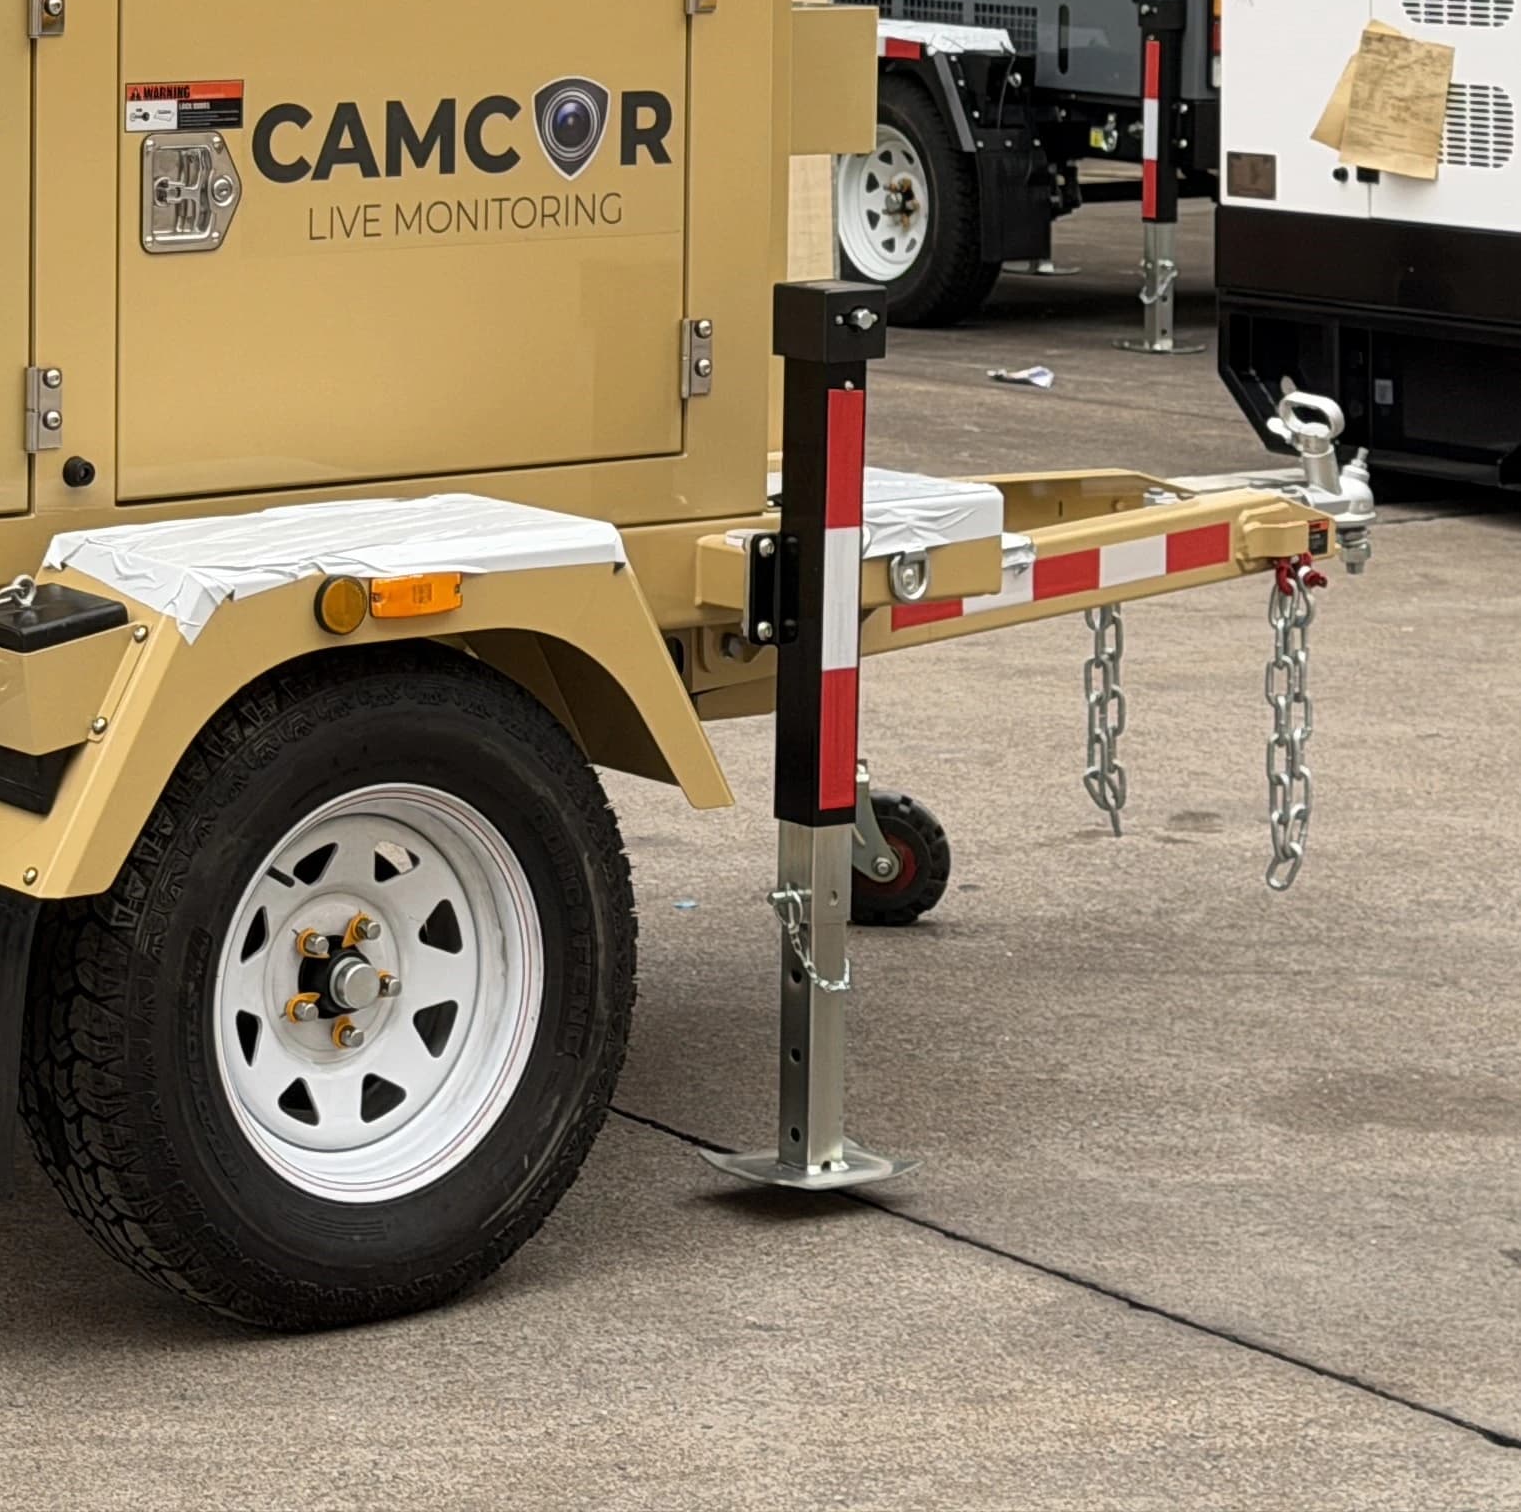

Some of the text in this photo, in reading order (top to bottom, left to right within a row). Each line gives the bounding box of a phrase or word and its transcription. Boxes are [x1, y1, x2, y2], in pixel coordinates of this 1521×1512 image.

[143, 85, 190, 99] WARNING
[307, 192, 623, 241] LIVE MONITORING
